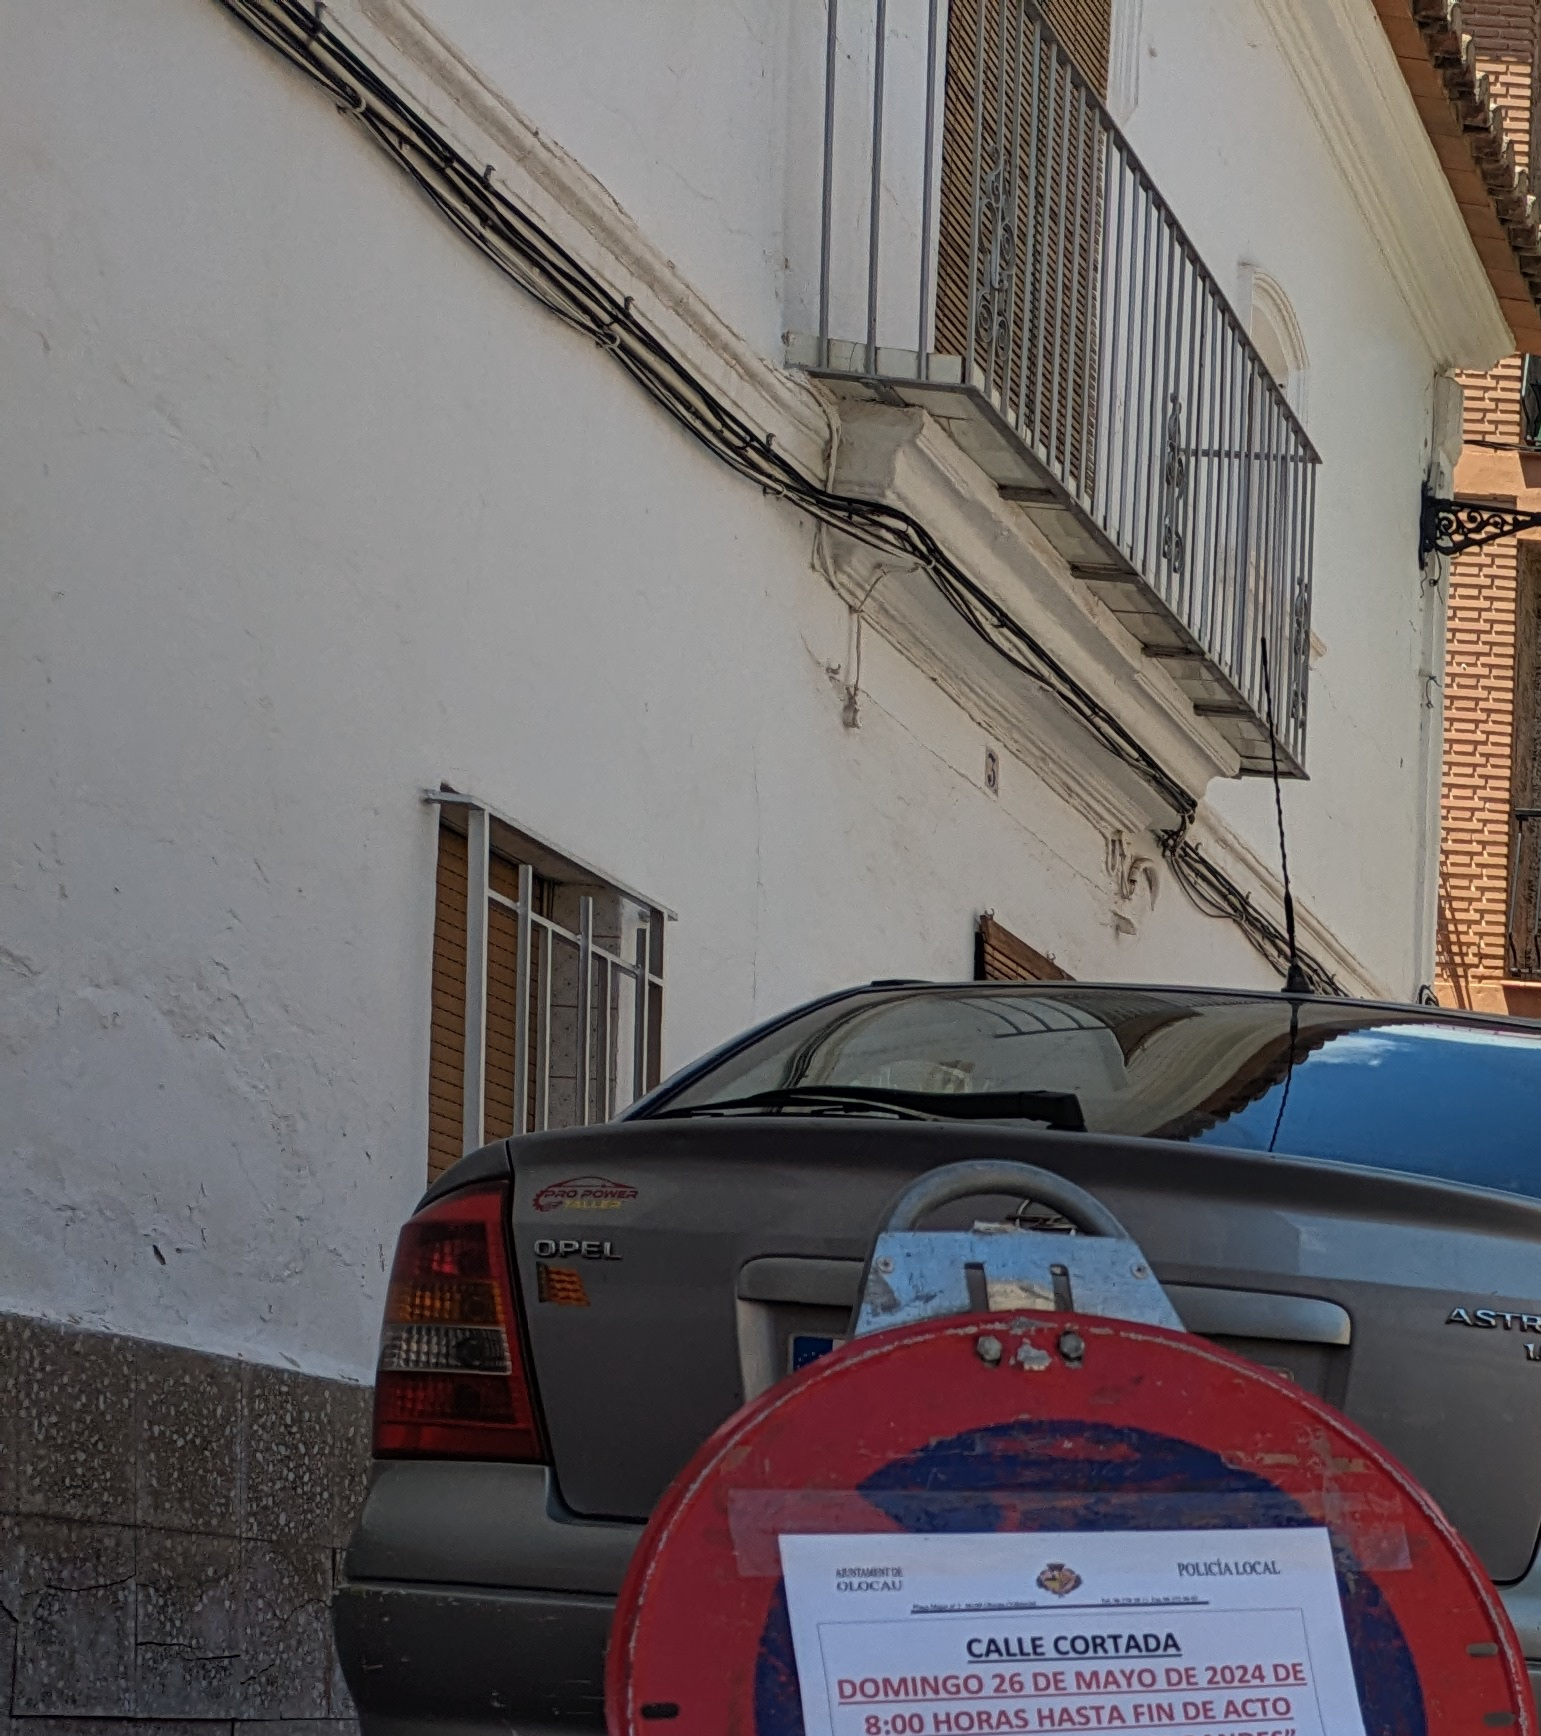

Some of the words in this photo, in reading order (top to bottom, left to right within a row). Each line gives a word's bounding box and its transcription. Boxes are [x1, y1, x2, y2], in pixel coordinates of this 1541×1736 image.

[987, 752, 997, 788] 3
[543, 1189, 578, 1199] PRO
[580, 1190, 639, 1199] POWER
[534, 1239, 623, 1261] OPEL
[1176, 1558, 1233, 1577] POLICÍA
[1234, 1560, 1282, 1576] LOCAL
[836, 1579, 902, 1593] OLOCAU
[966, 1636, 1046, 1659] CALLE
[1053, 1632, 1182, 1656] CORTADA
[837, 1674, 984, 1700] DOMINGO
[991, 1672, 1025, 1694] 26
[1032, 1671, 1068, 1692] DE
[1074, 1668, 1157, 1690] MAYO
[1164, 1667, 1199, 1687] DE
[1204, 1664, 1266, 1685] 2024
[1272, 1662, 1306, 1682] DE
[864, 1713, 925, 1736] 8:00
[932, 1708, 1029, 1733] HORAS
[1036, 1705, 1126, 1728] HASTA
[1132, 1702, 1175, 1723] FIN
[1182, 1700, 1217, 1721] DE
[1223, 1697, 1292, 1719] ACTO
